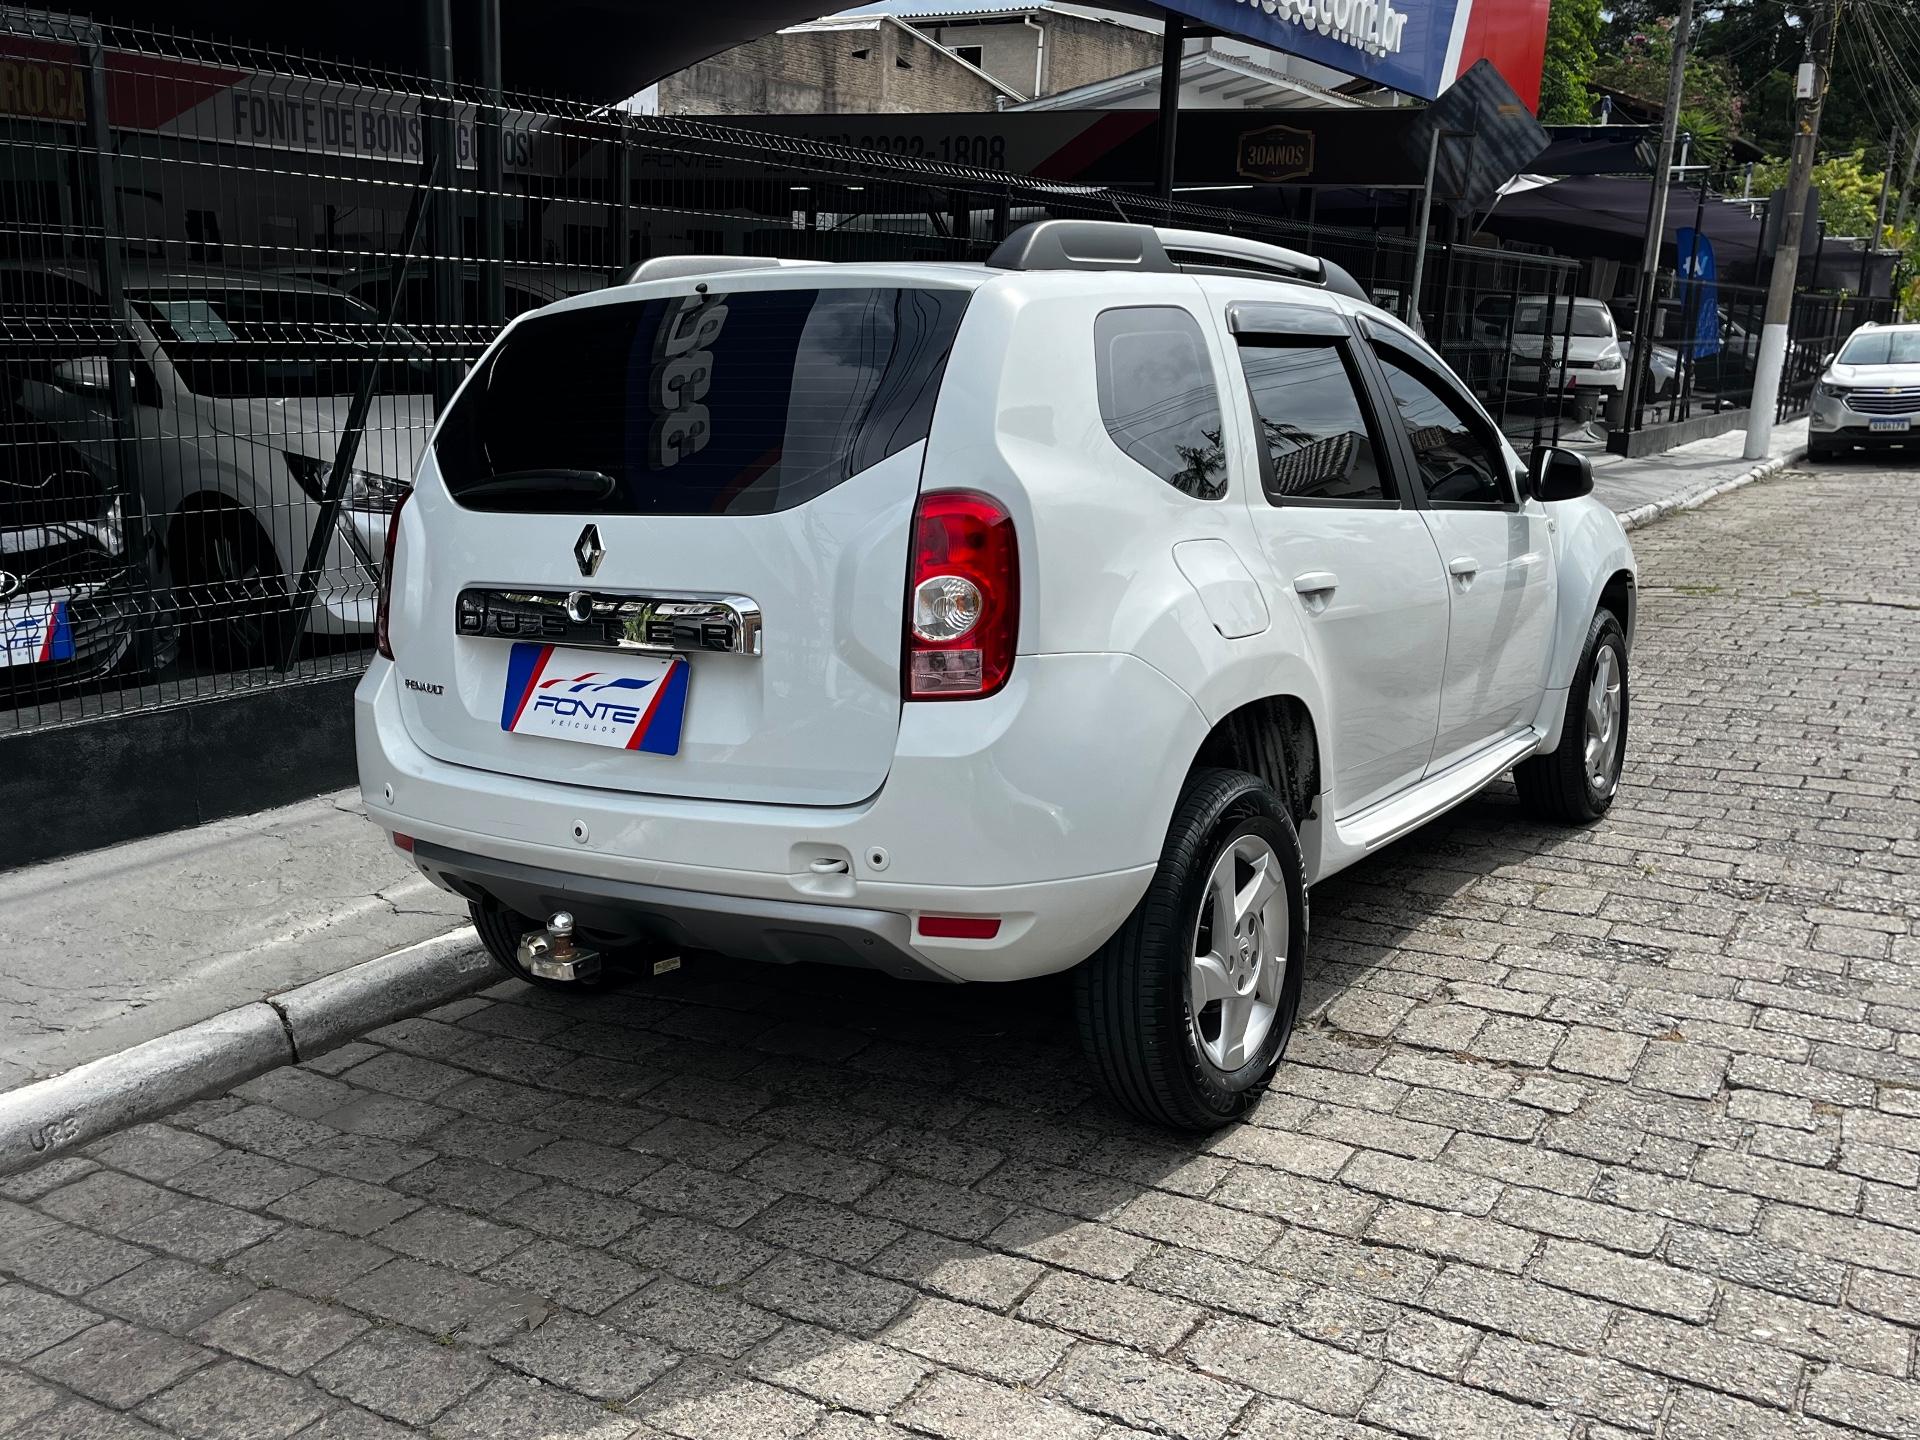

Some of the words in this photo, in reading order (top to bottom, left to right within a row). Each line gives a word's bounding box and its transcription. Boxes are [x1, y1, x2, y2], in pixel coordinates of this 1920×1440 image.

[234, 94, 317, 144] FONTE
[323, 106, 355, 148] DE
[362, 110, 421, 157] BONS
[459, 608, 736, 650] DUSTER
[404, 678, 444, 696] RENAULT
[534, 695, 640, 724] FONTE
[551, 718, 617, 734] VEÍCULOS
